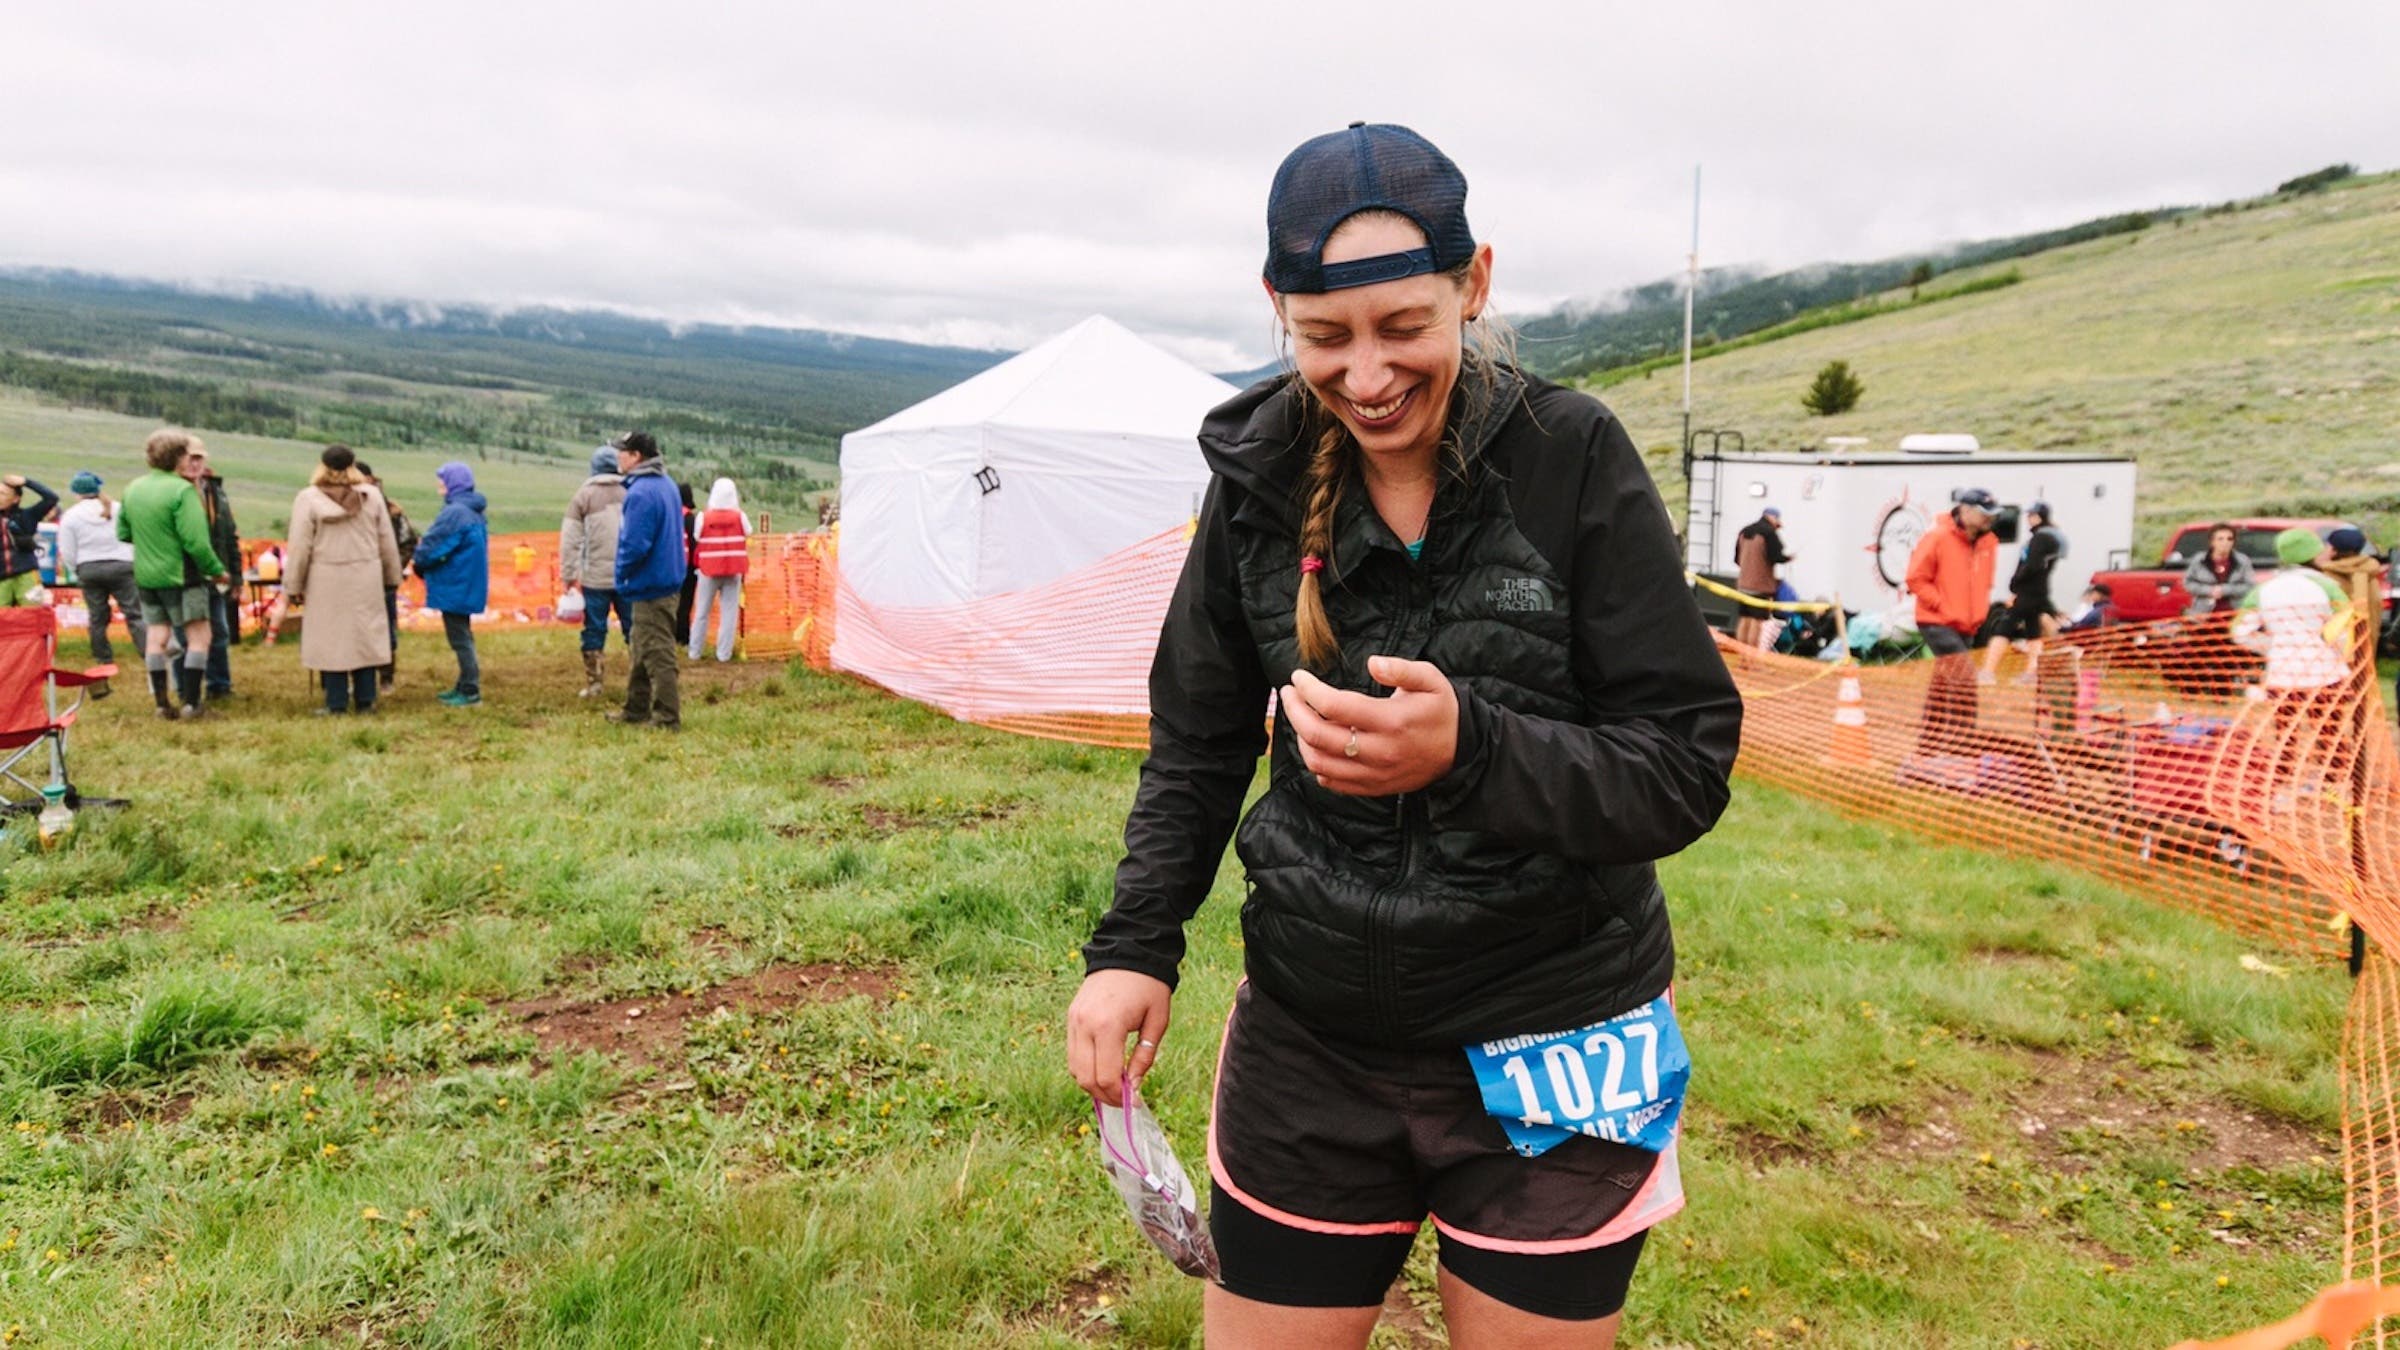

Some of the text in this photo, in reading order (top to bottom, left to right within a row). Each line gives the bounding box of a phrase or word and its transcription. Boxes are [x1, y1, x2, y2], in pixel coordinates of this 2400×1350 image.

[1502, 578, 1529, 589] THE
[1485, 589, 1529, 601] NORTH
[1496, 600, 1529, 611] FACE
[1482, 1029, 1576, 1057] BIGHO
[1502, 1021, 1659, 1128] 1027
